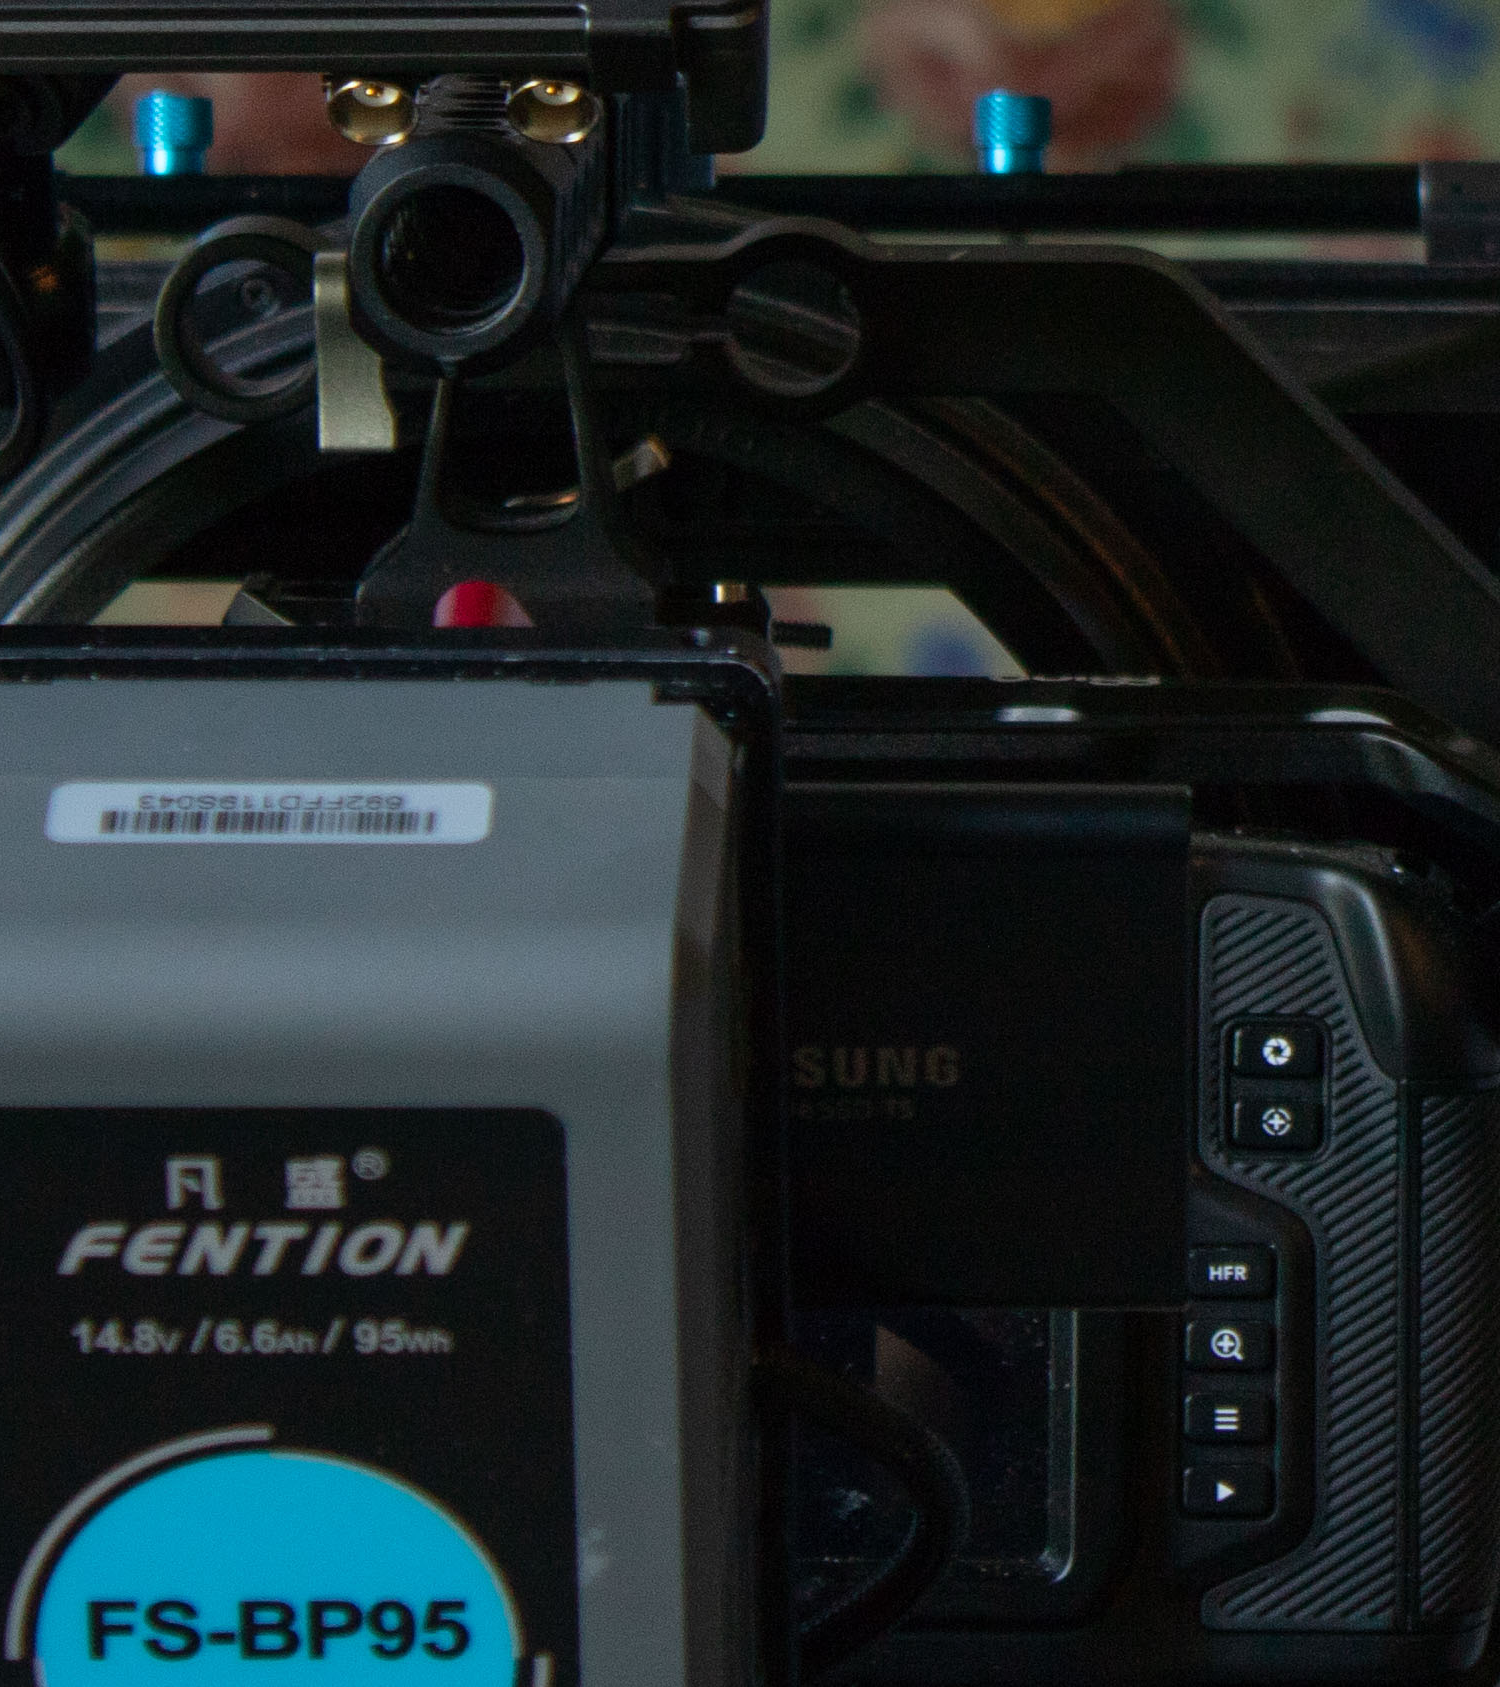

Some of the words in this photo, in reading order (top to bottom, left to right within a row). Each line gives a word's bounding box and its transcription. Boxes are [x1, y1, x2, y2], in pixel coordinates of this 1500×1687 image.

[791, 1046, 960, 1088] SUNG
[56, 1219, 470, 1277] FENTION
[1208, 1265, 1248, 1282] HFR
[88, 1599, 470, 1660] FS-BP95
